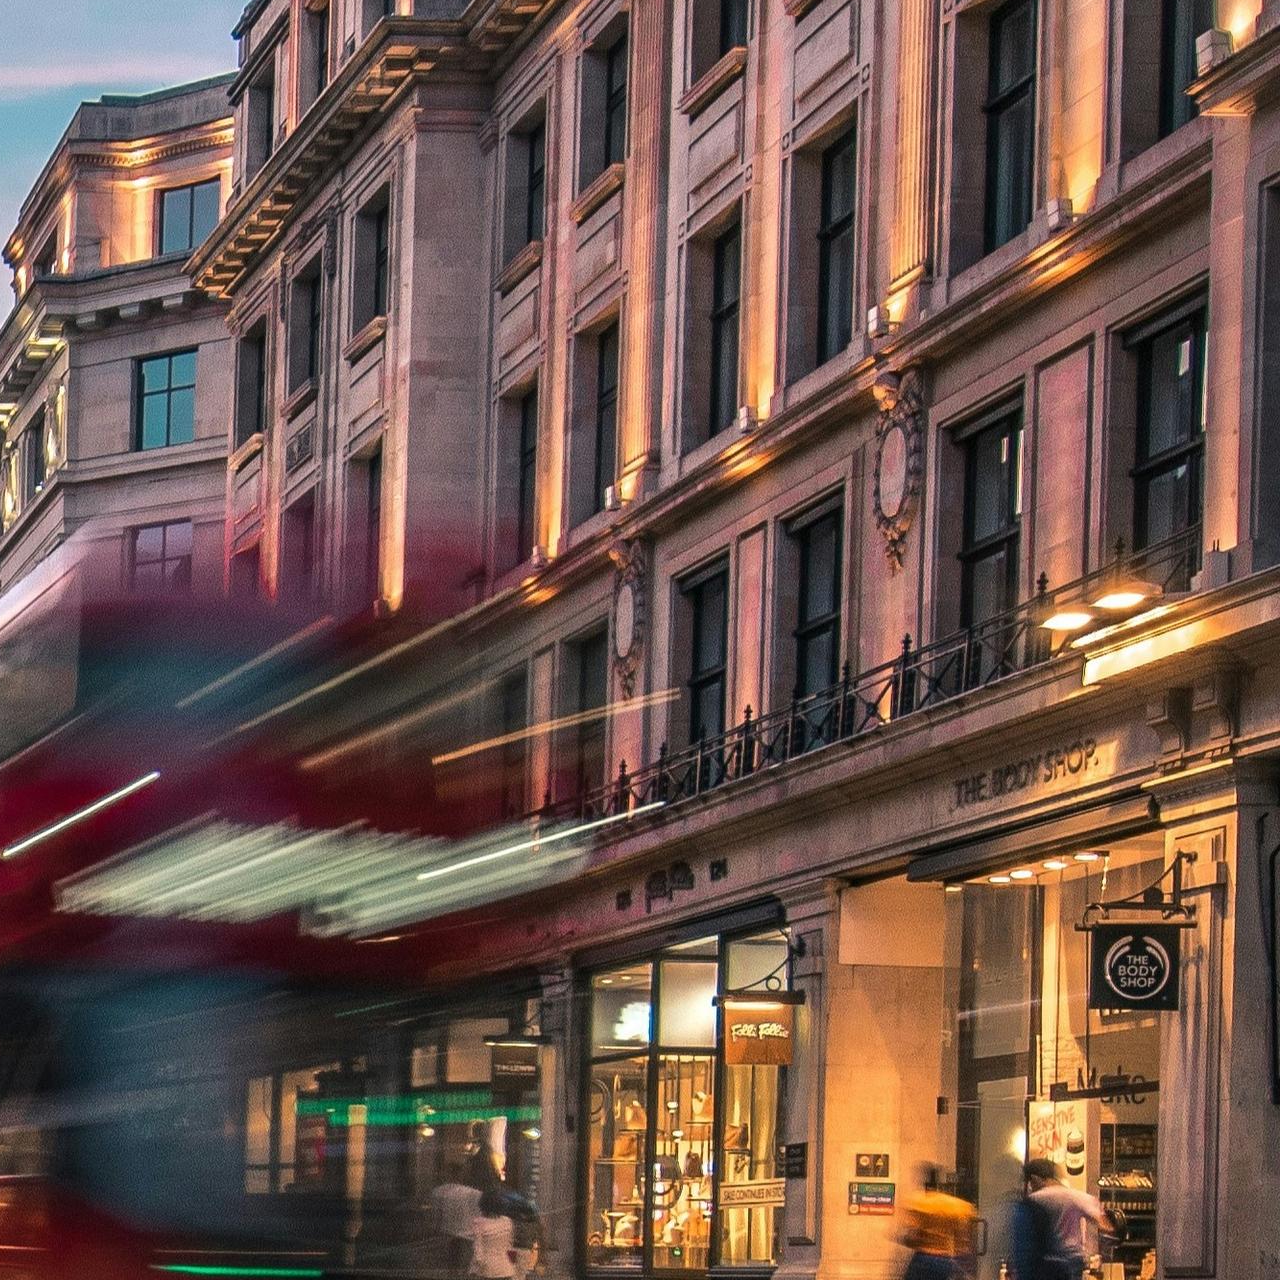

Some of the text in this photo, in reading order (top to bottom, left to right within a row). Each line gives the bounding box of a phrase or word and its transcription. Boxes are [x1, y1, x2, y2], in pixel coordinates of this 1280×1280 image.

[953, 772, 990, 807] THE
[991, 754, 1042, 796] BODY
[1127, 955, 1149, 965] THE
[1118, 965, 1158, 976] BODY
[1120, 977, 1156, 988] SHOP
